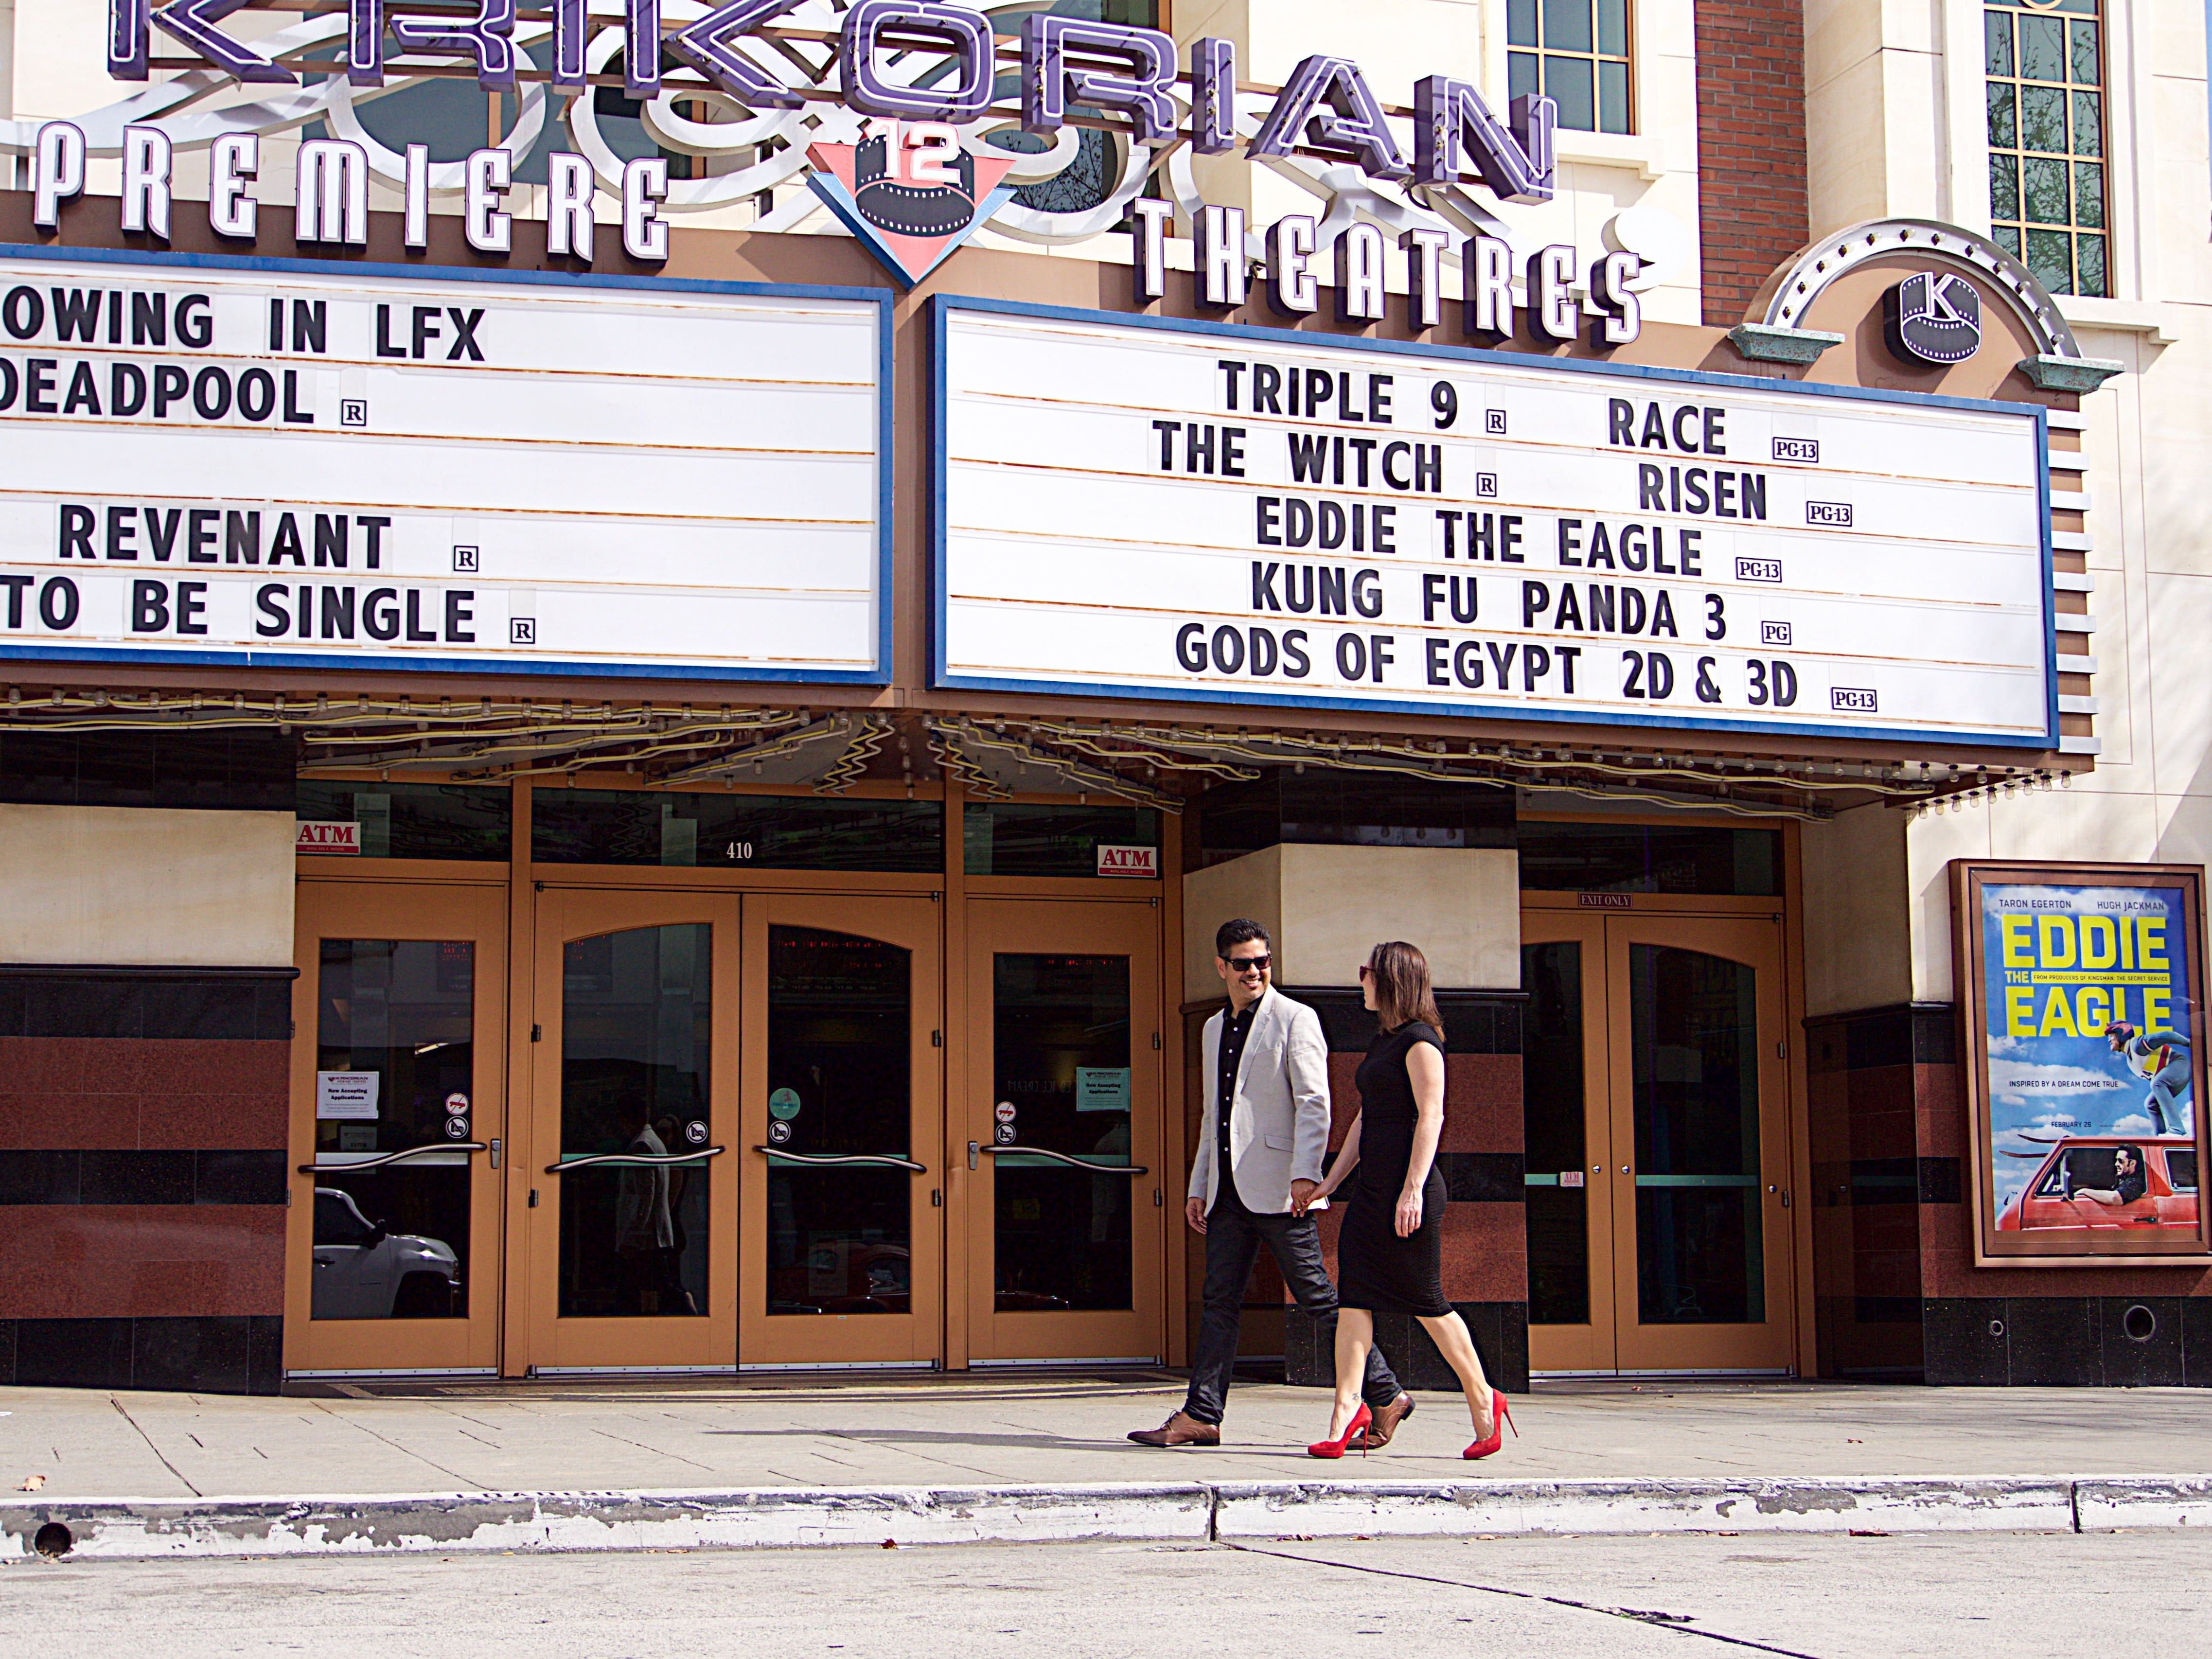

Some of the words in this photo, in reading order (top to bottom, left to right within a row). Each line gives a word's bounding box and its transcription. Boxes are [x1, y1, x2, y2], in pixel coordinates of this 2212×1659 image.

[107, 0, 1557, 205] KRIKORIAN
[864, 117, 961, 183] 12
[34, 121, 668, 263] PREMIERE
[1127, 197, 1640, 344] THEATRES
[2, 285, 213, 349] OWING
[269, 298, 327, 354] IN
[376, 303, 486, 362] LFX
[1218, 359, 1394, 424] TRIPLE
[1431, 380, 1458, 430] 9
[1152, 419, 1246, 478] THE
[1287, 432, 1442, 494] WITCH
[1609, 397, 1726, 456] RACE
[1638, 462, 1767, 521] RISEN
[59, 504, 391, 569] REVENANT
[1256, 495, 1397, 554] EDDIE
[1435, 509, 1525, 564] THE
[1557, 518, 1702, 577] EAGLE
[0, 574, 80, 631] TO
[131, 579, 208, 635] BE
[255, 583, 476, 643] SINGLE
[1252, 561, 1383, 619] KUNG
[1422, 573, 1478, 624] FU
[1522, 580, 1679, 638] PANDA
[1705, 593, 1727, 641] 3
[1175, 622, 1311, 679] GODS
[1335, 632, 1395, 683] OF
[1425, 637, 1582, 694] EGYPT
[1622, 650, 1674, 700] 2D
[1695, 655, 1724, 704] &
[1747, 658, 1798, 707] 3D
[297, 824, 354, 844] ATM
[726, 842, 752, 859] 410
[1102, 849, 1151, 867] ATM
[1581, 895, 1603, 905] EXIT
[1604, 896, 1630, 906] ONLY
[1999, 899, 2028, 908] TARON
[2031, 900, 2071, 909] EGERTON
[2097, 901, 2121, 910] HUGH
[2124, 901, 2164, 911] JACKMAN
[2001, 914, 2170, 970] EDDIE
[2005, 971, 2029, 983] THE
[2005, 986, 2173, 1038] EAGLE
[2141, 1070, 2153, 1081] 24
